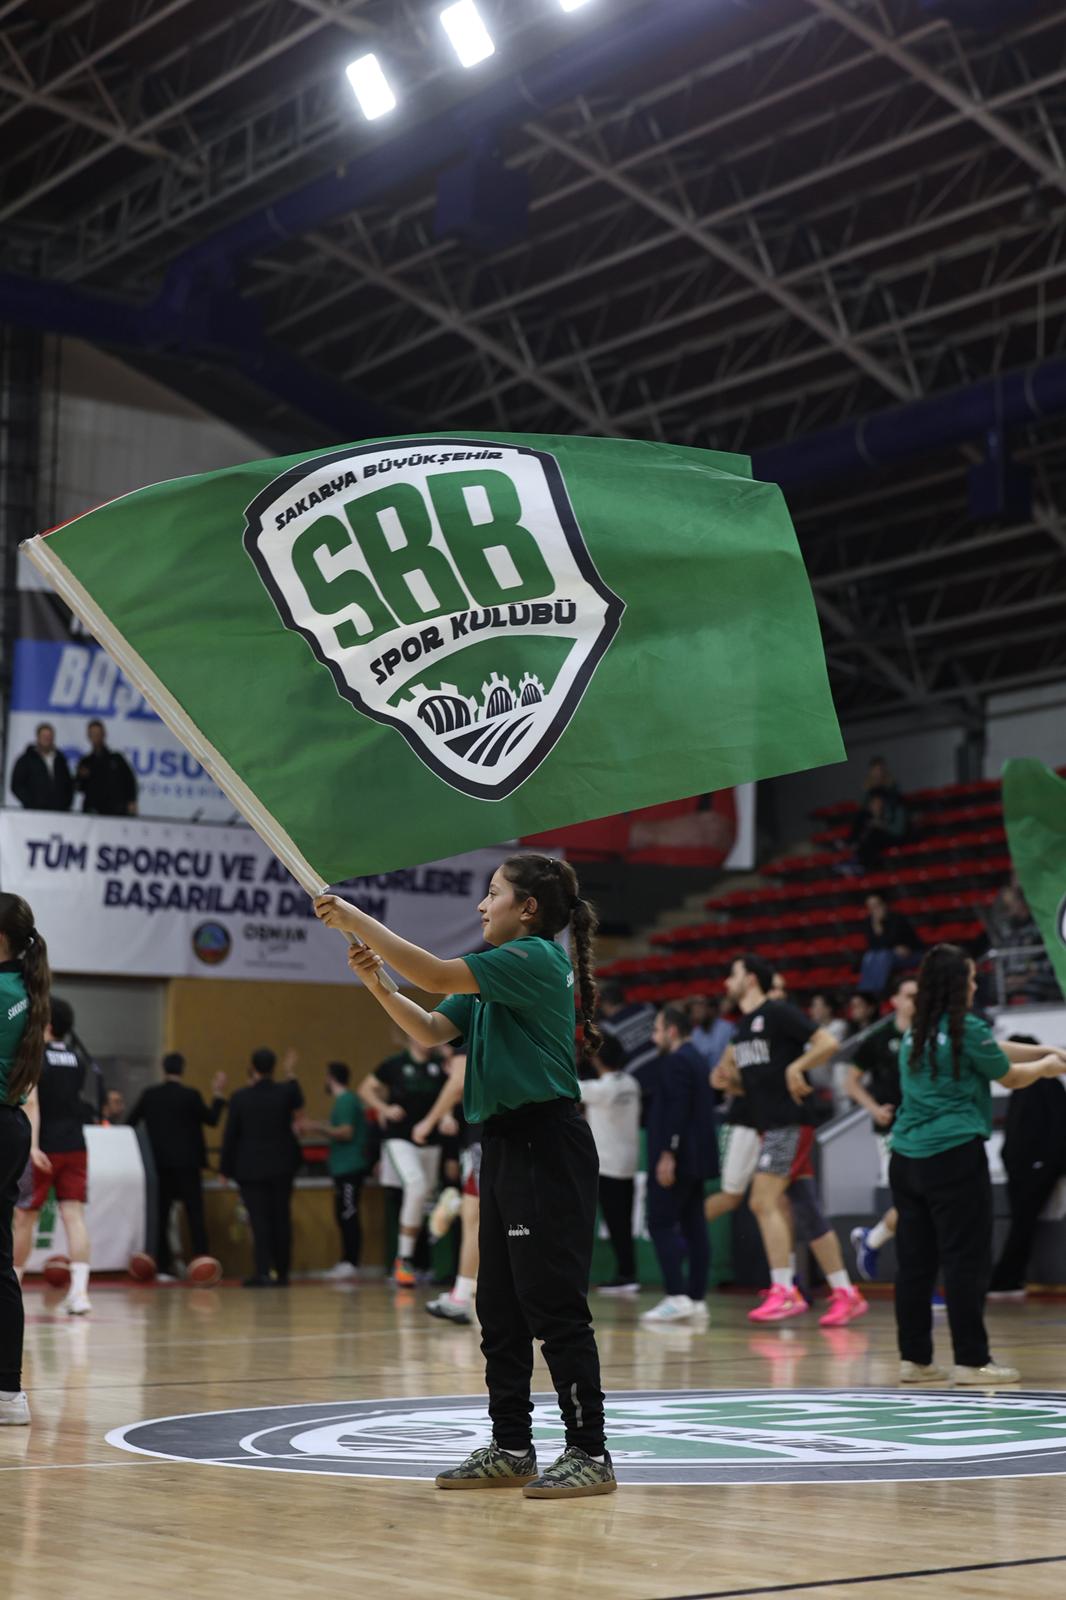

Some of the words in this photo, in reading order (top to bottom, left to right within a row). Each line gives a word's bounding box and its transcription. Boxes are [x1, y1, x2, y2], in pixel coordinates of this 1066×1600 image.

[274, 470, 358, 531] SAKARYA
[363, 449, 504, 480] BÜYÜKŞEHİR
[291, 468, 557, 650] SBB
[369, 625, 445, 686] SPOR
[450, 598, 577, 641] KULÜBÜ
[50, 645, 157, 721] BAŞ
[26, 834, 88, 872] TÜM
[96, 844, 212, 879] SPORCU
[219, 852, 255, 883] VE
[103, 879, 274, 916] BAŞARILAR
